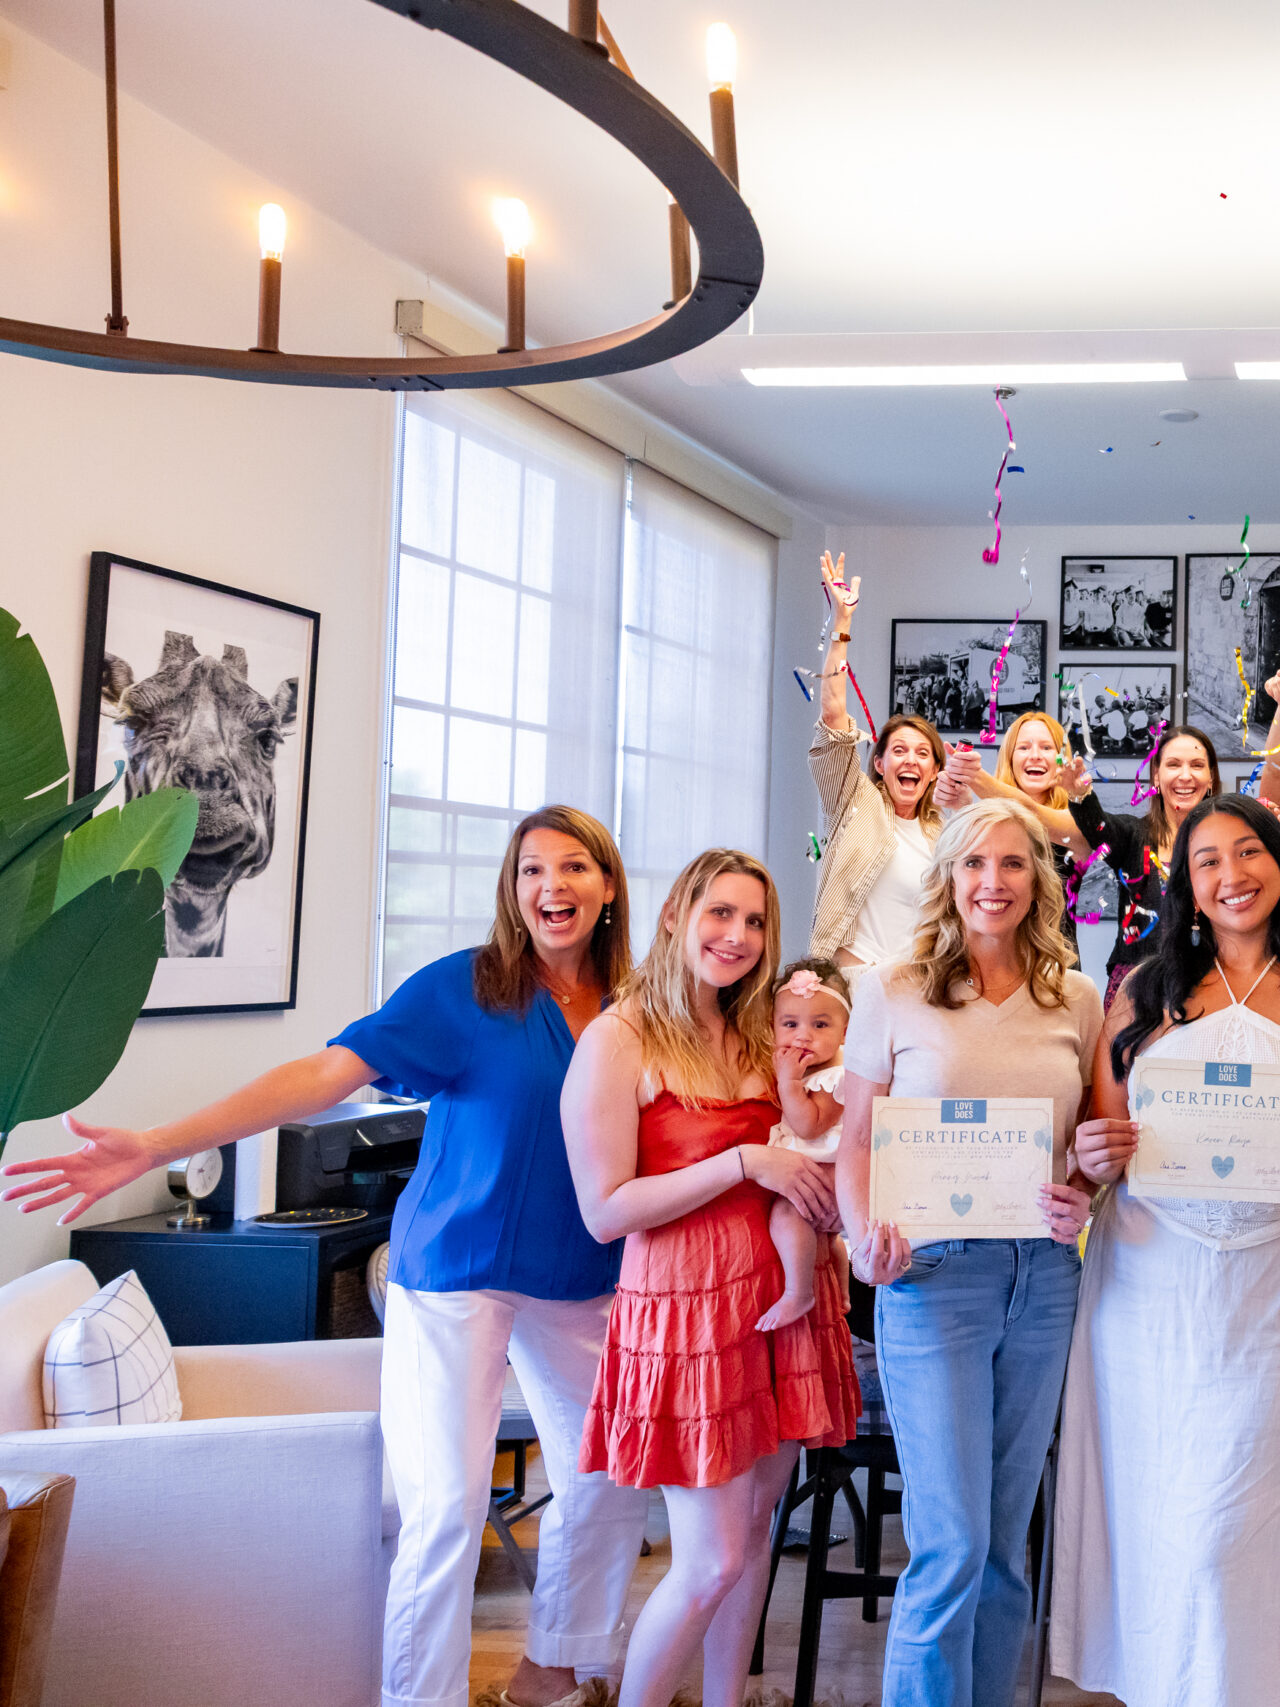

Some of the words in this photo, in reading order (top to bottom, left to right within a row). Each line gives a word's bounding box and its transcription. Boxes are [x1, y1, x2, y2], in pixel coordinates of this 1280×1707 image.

[1218, 1064, 1238, 1074] LOVE
[1218, 1073, 1238, 1082] DOES
[954, 1102, 974, 1110] LOVE
[954, 1110, 974, 1119] DOES
[899, 1130, 1028, 1144] CERTIFICATE
